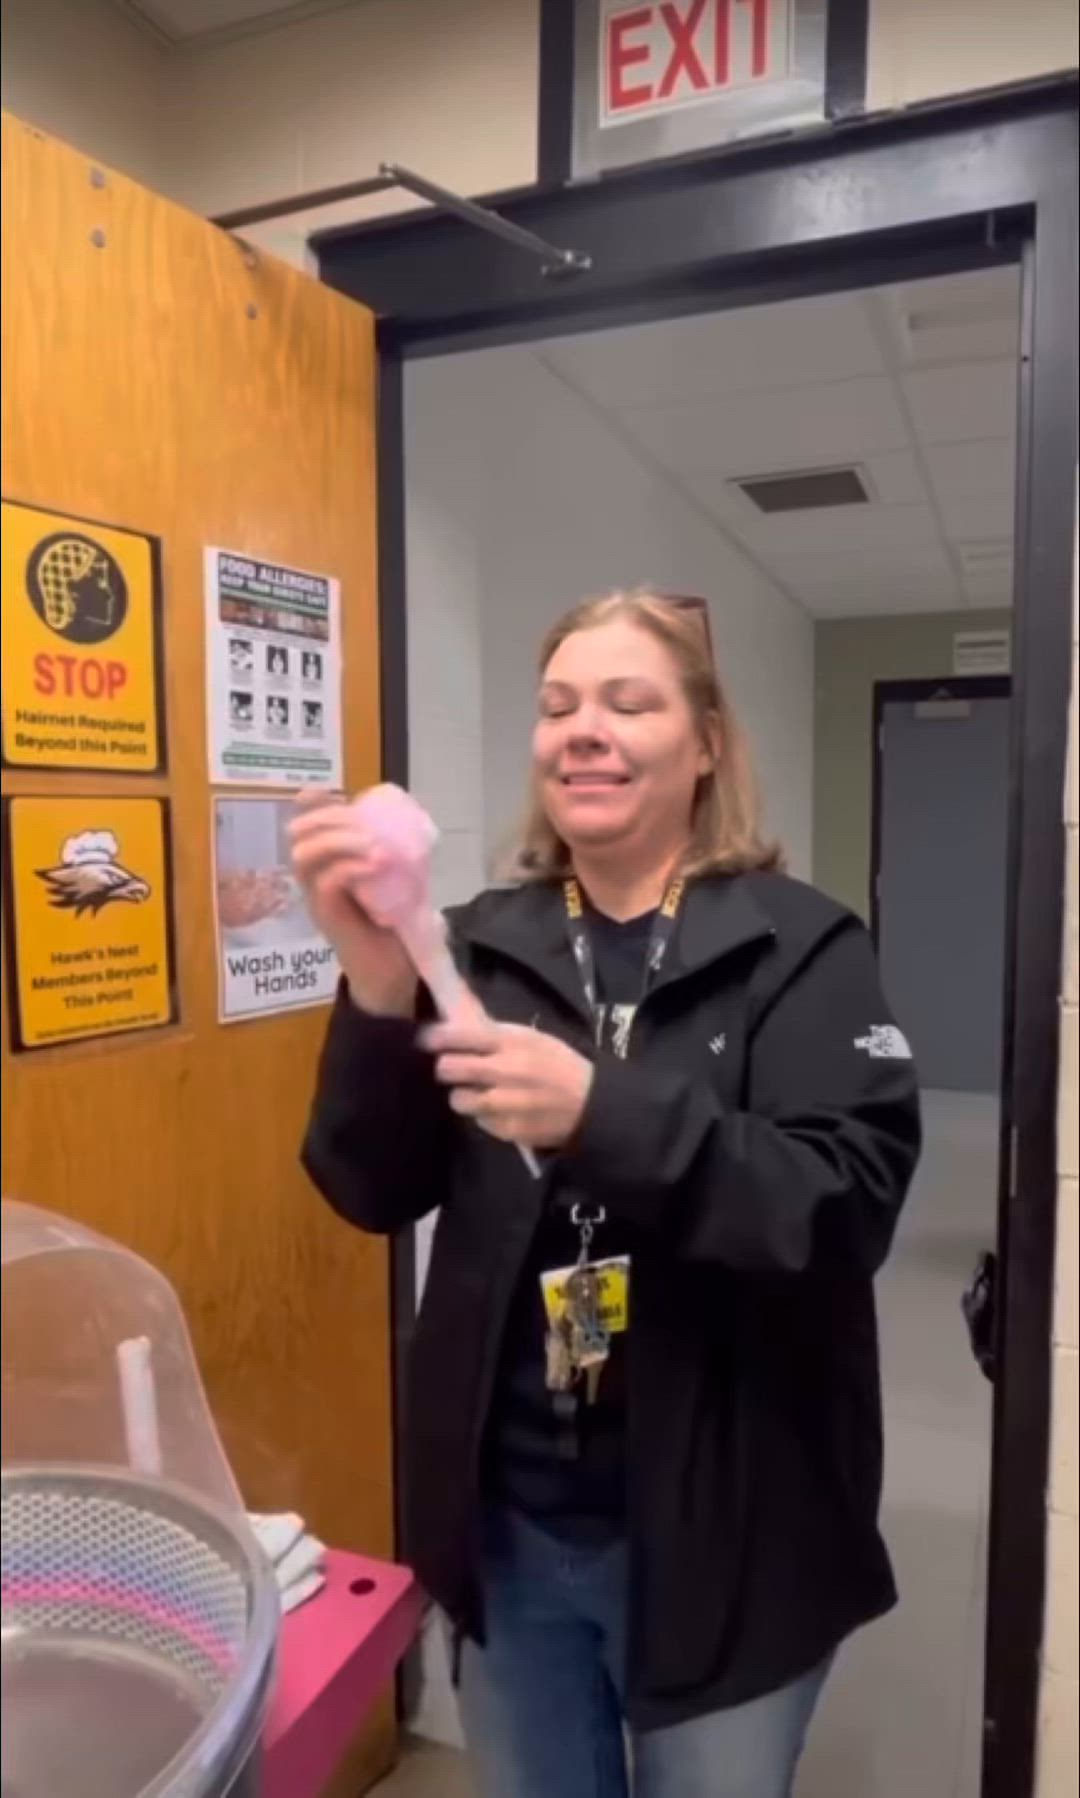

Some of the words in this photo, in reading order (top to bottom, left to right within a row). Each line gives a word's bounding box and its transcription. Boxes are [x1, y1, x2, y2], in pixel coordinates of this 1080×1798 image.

[608, 0, 769, 111] EXIT
[219, 556, 257, 579] FOOD
[33, 652, 127, 700] STOP
[15, 709, 75, 727] Hairnet
[78, 715, 146, 734] Required
[15, 733, 77, 752] Beyond
[80, 738, 107, 753] this
[110, 741, 147, 756] Point
[50, 948, 105, 965] Hawk's
[227, 949, 285, 977] Wash
[291, 947, 336, 973] your
[32, 969, 103, 990] Members
[105, 963, 158, 982] Beyond
[255, 967, 318, 996] Hands
[63, 994, 94, 1009] This
[97, 988, 134, 1003] Point
